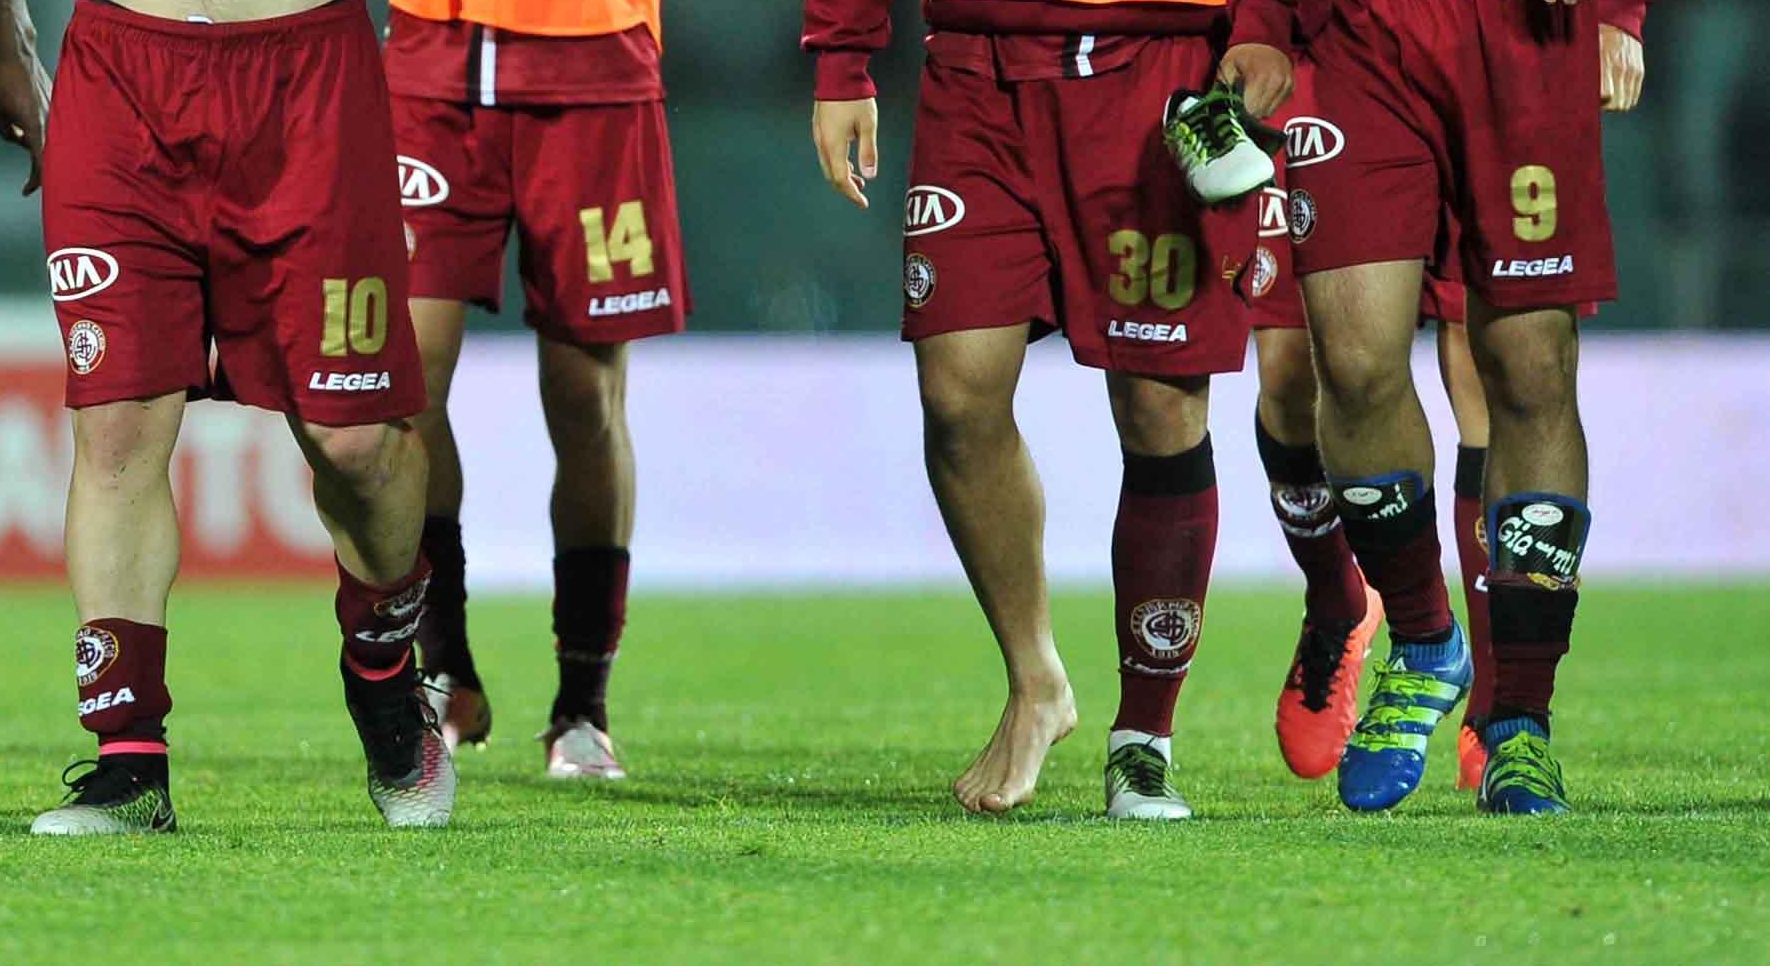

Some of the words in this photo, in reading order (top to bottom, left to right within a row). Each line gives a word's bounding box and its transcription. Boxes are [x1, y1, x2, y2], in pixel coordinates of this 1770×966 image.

[1510, 165, 1557, 242] 9
[579, 200, 655, 283] 14
[49, 255, 103, 292] KIA
[1107, 229, 1197, 311] 30
[1492, 255, 1575, 278] LEGEA
[320, 276, 388, 357] 10
[588, 287, 672, 316] LEGEA
[1108, 319, 1188, 343] LEGEA
[308, 371, 391, 391] LEGEA
[77, 686, 135, 717] GEA
